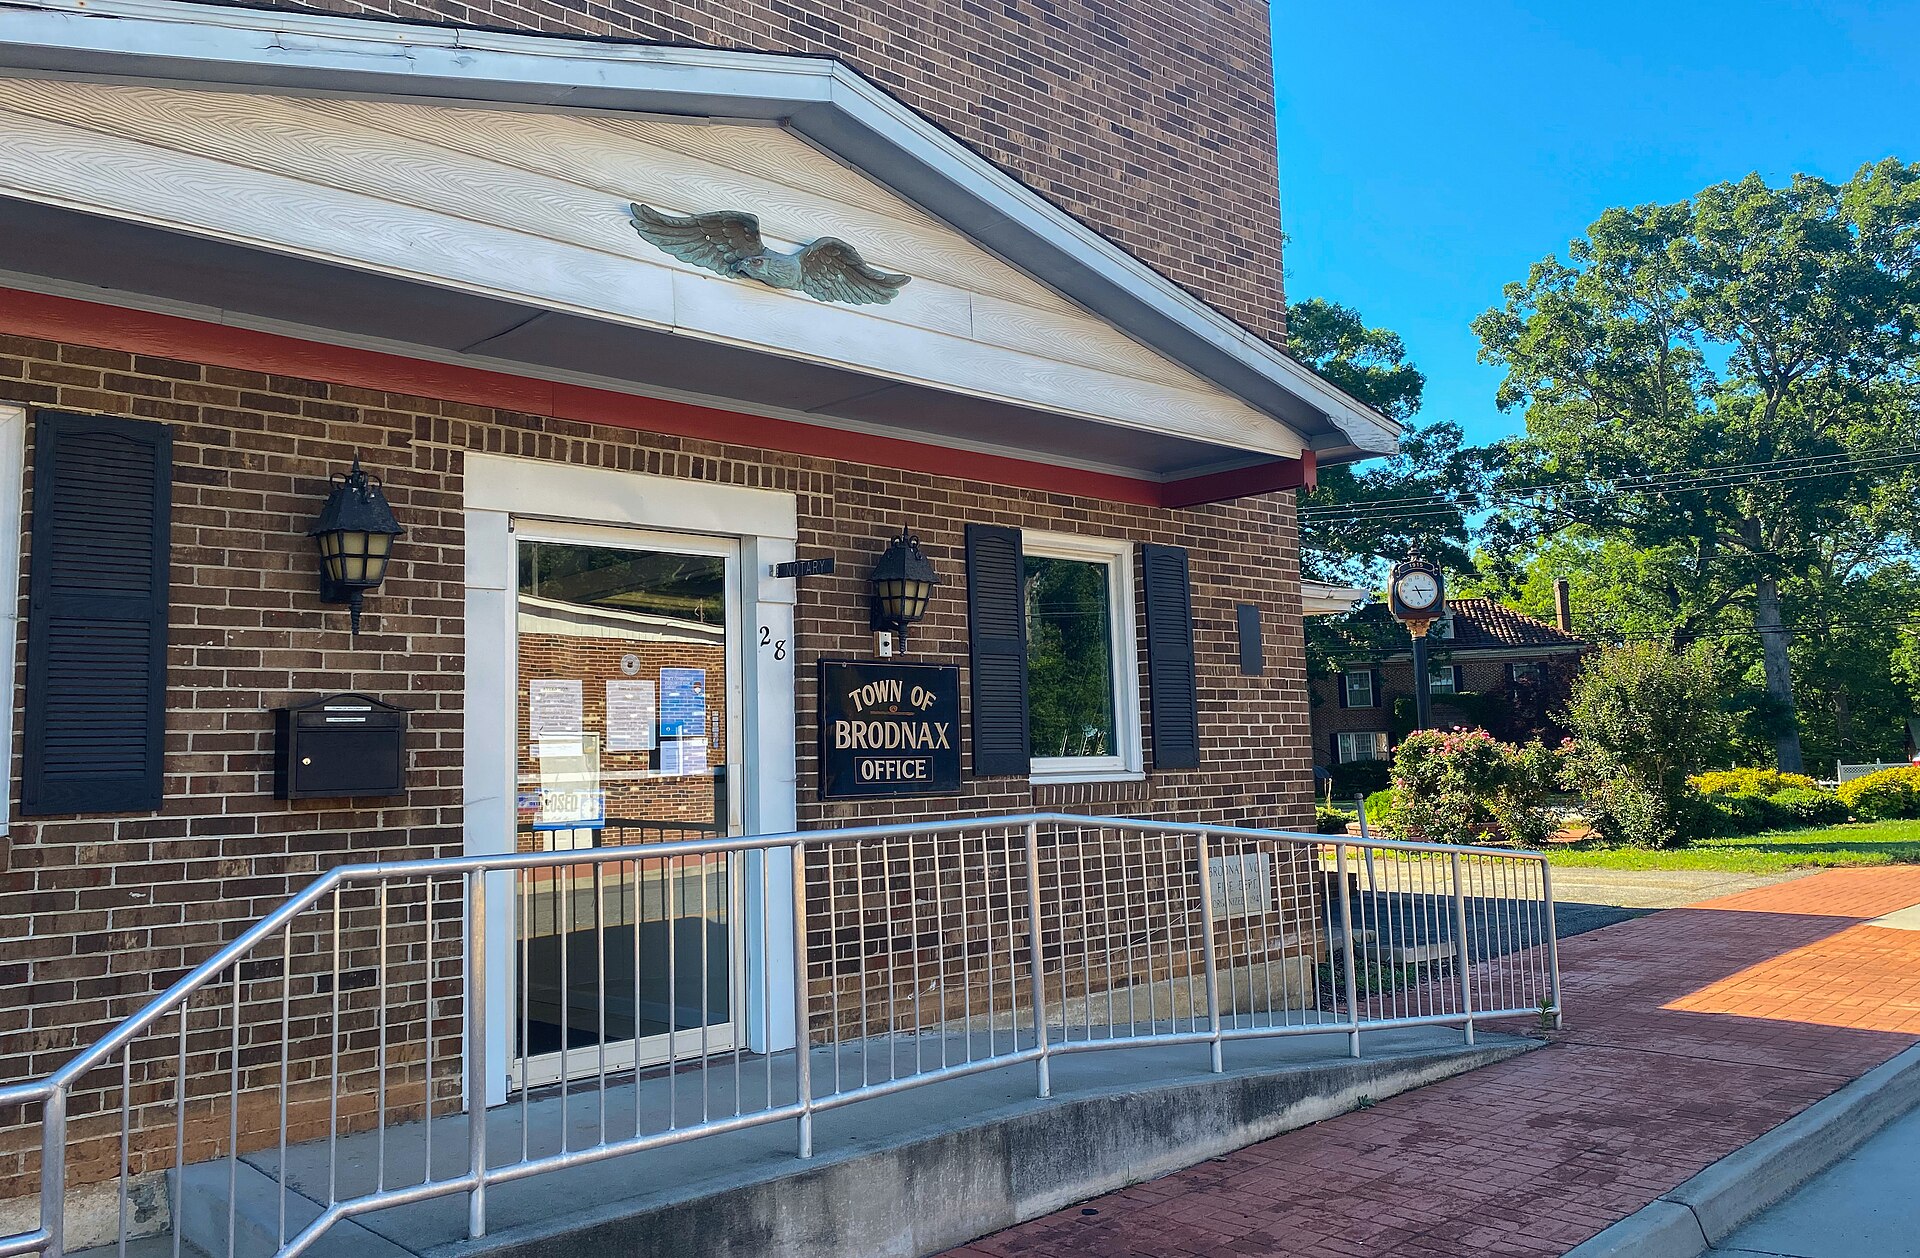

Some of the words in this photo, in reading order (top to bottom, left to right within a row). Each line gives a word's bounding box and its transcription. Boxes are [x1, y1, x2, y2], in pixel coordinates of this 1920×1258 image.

[786, 560, 825, 576] NOTARY
[759, 626, 786, 660] 28
[848, 679, 903, 712] TOWN
[910, 685, 937, 711] OF
[835, 720, 951, 749] BRODNAX
[861, 759, 927, 780] OFFICE
